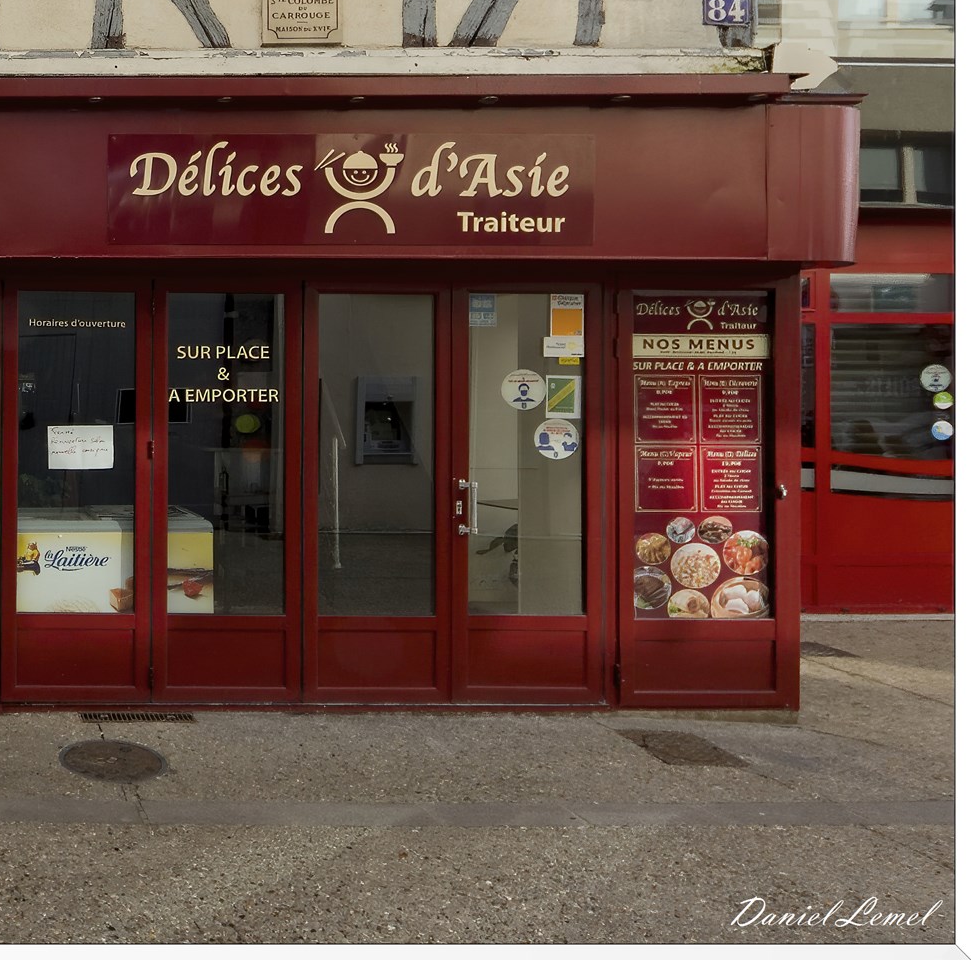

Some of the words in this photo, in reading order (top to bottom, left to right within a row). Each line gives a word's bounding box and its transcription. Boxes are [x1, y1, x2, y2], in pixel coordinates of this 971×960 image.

[271, 11, 331, 20] CARROUGE
[129, 141, 304, 197] Délices
[411, 141, 570, 197] d'Asie
[456, 211, 567, 233] Traiteur
[635, 300, 680, 316] Délices
[717, 300, 759, 316] d'Asie
[28, 318, 69, 328] Horaires
[70, 318, 127, 329] d'ouverture
[642, 338, 681, 350] NOS
[688, 338, 755, 350] MENUS
[176, 345, 211, 360] SUR
[216, 345, 270, 360] PLACE
[632, 361, 652, 371] SUR
[654, 361, 684, 371] PLACE
[686, 361, 695, 371] &
[697, 361, 705, 371] A
[707, 361, 763, 371] EMPORTER
[216, 366, 231, 382] &
[168, 388, 181, 403] A
[185, 388, 280, 403] EMPORTER
[44, 549, 110, 569] Laitière
